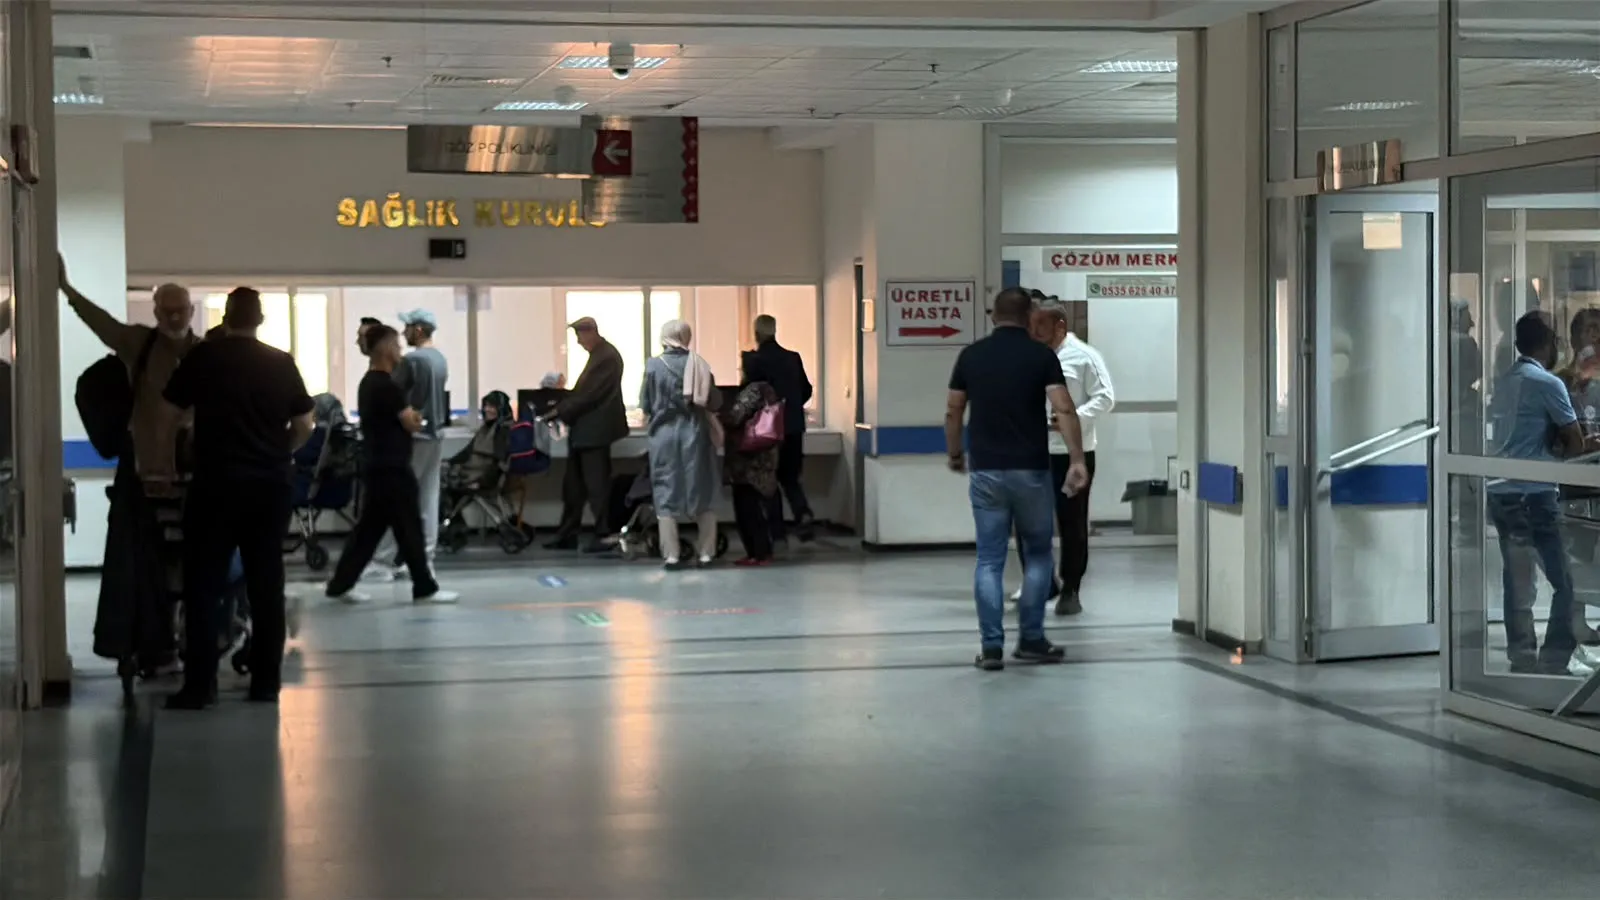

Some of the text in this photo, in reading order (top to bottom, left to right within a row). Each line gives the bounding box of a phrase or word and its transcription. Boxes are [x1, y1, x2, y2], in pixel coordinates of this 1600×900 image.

[336, 191, 459, 228] SAĞLIK
[1051, 251, 1120, 269] ÇÖZÜM
[891, 287, 970, 303] ÜCRETLİ
[901, 307, 962, 320] HASTA
